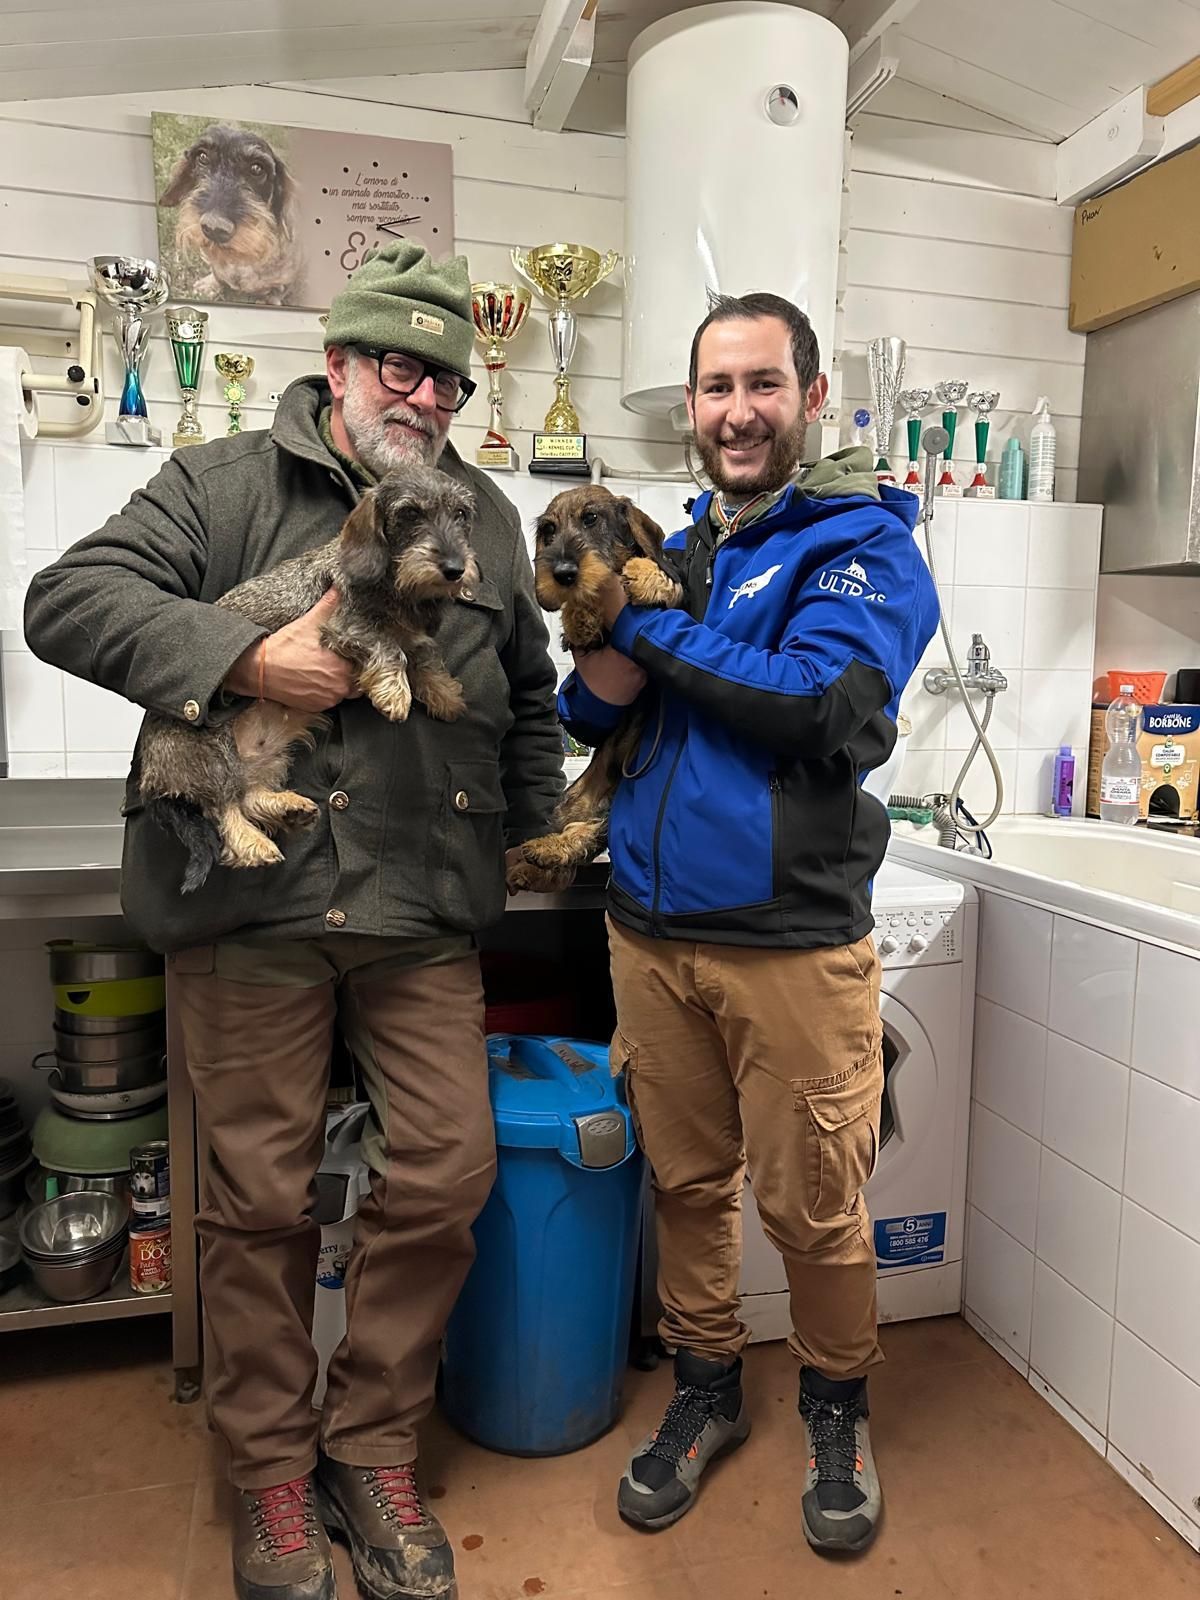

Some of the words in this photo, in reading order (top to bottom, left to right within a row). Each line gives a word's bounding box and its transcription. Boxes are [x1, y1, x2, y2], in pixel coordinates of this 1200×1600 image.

[390, 176, 398, 186] di
[328, 188, 339, 197] un
[341, 187, 371, 198] animale
[1149, 716, 1192, 728] BORBONE
[906, 1220, 915, 1232] 5
